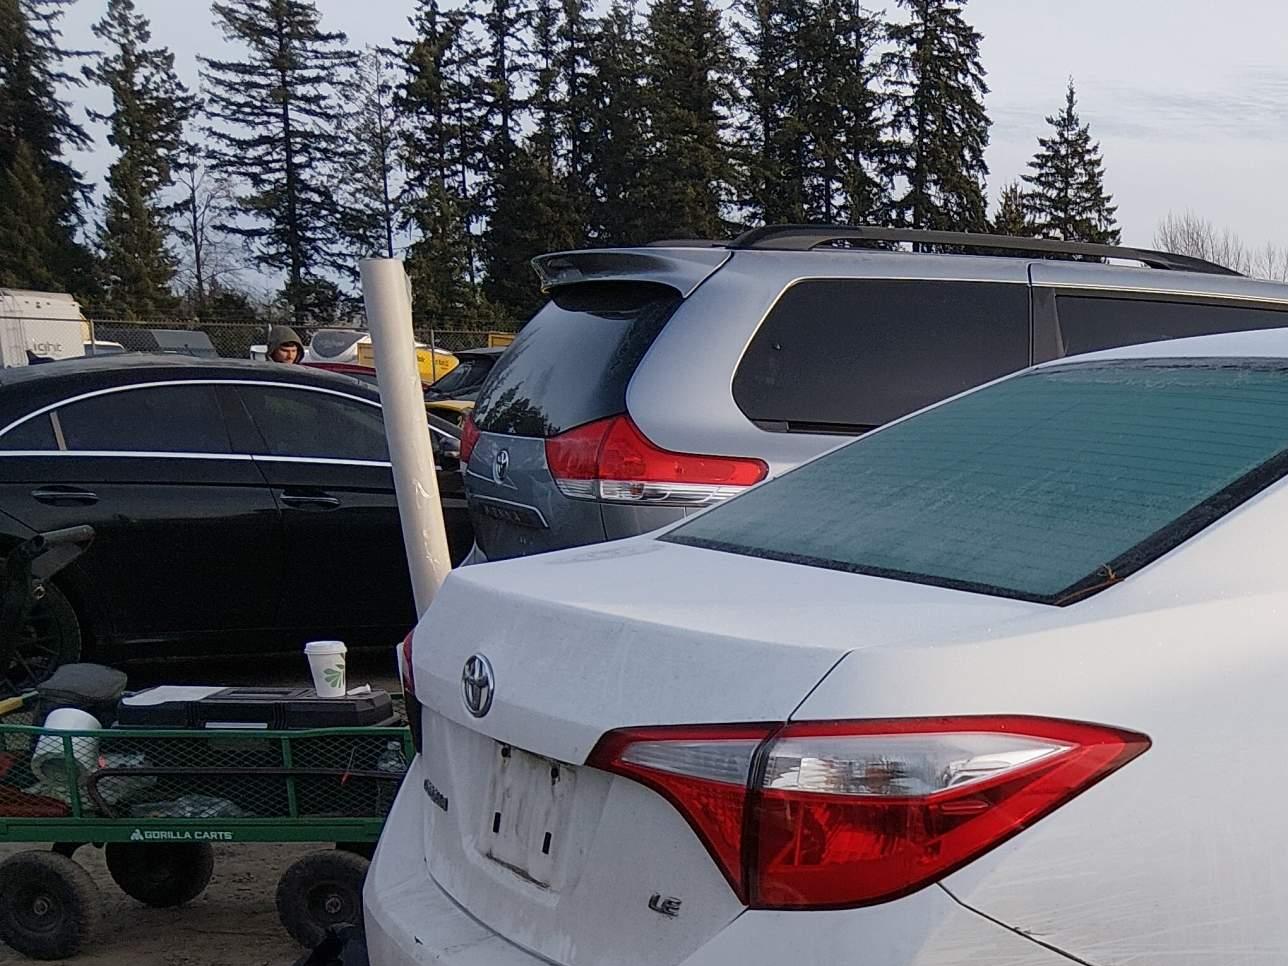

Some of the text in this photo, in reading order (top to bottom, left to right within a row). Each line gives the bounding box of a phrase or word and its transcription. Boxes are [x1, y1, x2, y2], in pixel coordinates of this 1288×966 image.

[144, 830, 232, 841] GORILLA CARTS
[648, 892, 682, 917] LE
